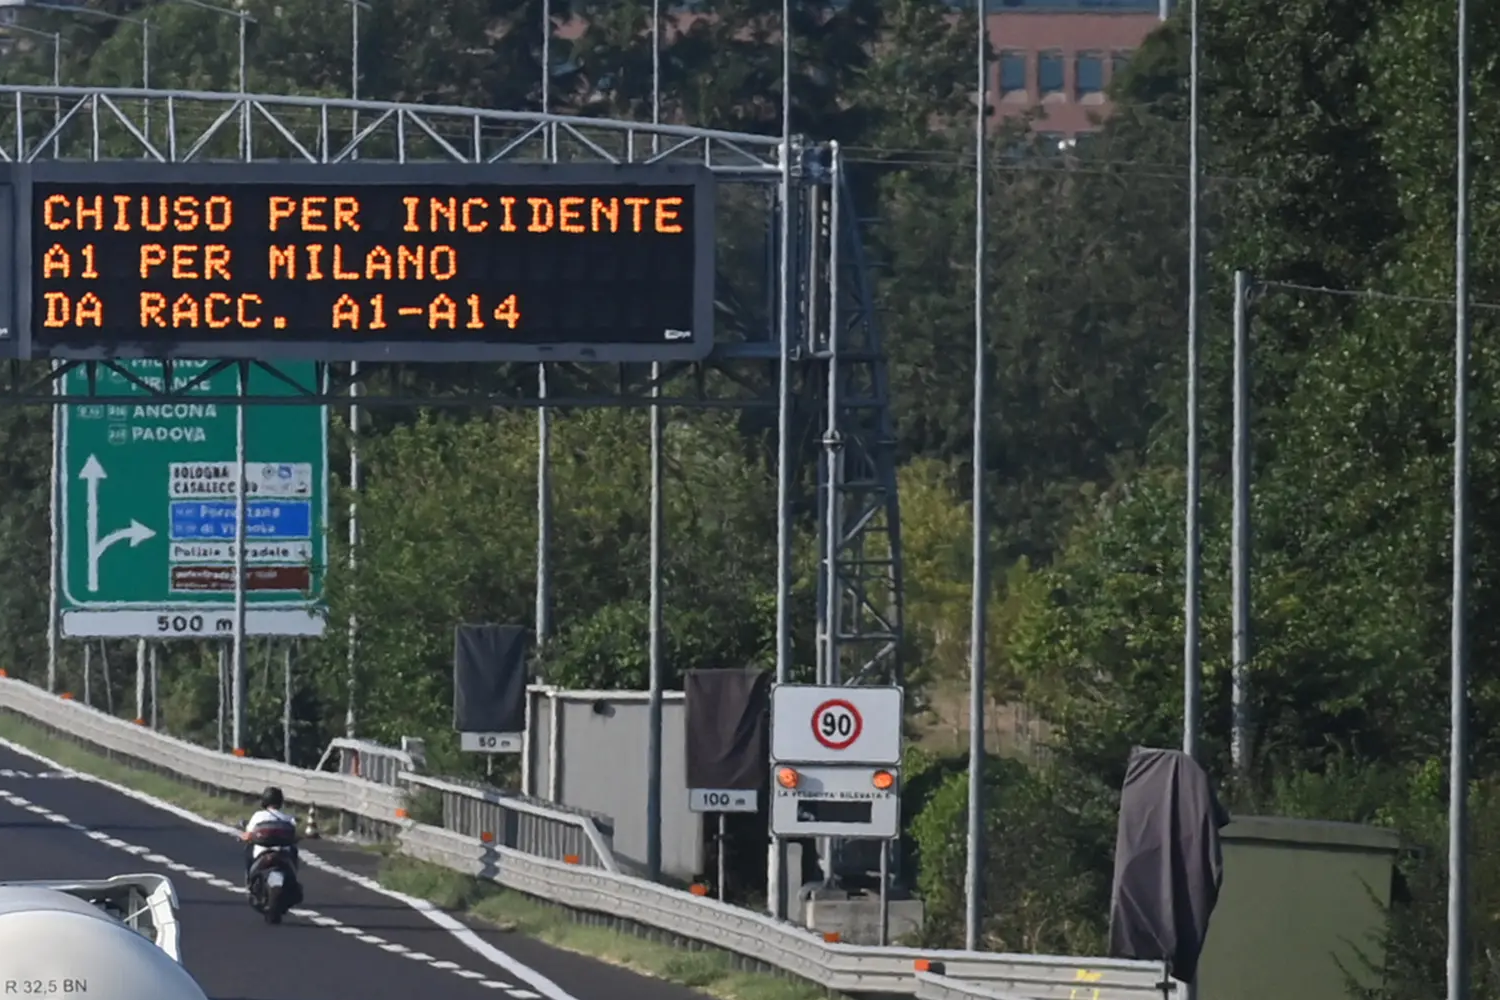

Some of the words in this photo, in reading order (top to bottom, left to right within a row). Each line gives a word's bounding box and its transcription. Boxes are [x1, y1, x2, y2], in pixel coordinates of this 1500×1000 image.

[44, 195, 232, 232] CHIUSO
[269, 196, 361, 232] PER
[403, 197, 683, 233] INCIDENTE
[43, 244, 99, 279] A1
[139, 244, 232, 281] PER
[269, 244, 457, 281] MILANO
[43, 292, 103, 328] DA
[140, 292, 287, 329] RACC.
[332, 294, 521, 330] A1-A14
[132, 404, 217, 418] ANCONA
[132, 426, 207, 441] PADOVA
[228, 545, 289, 557] Sradale
[157, 616, 204, 632] 500
[216, 618, 233, 632] m
[822, 712, 852, 737] 90
[479, 736, 497, 748] 50
[703, 792, 730, 806] 100
[5, 980, 18, 994] R
[23, 979, 58, 995] 32,5
[63, 979, 88, 993] BN
